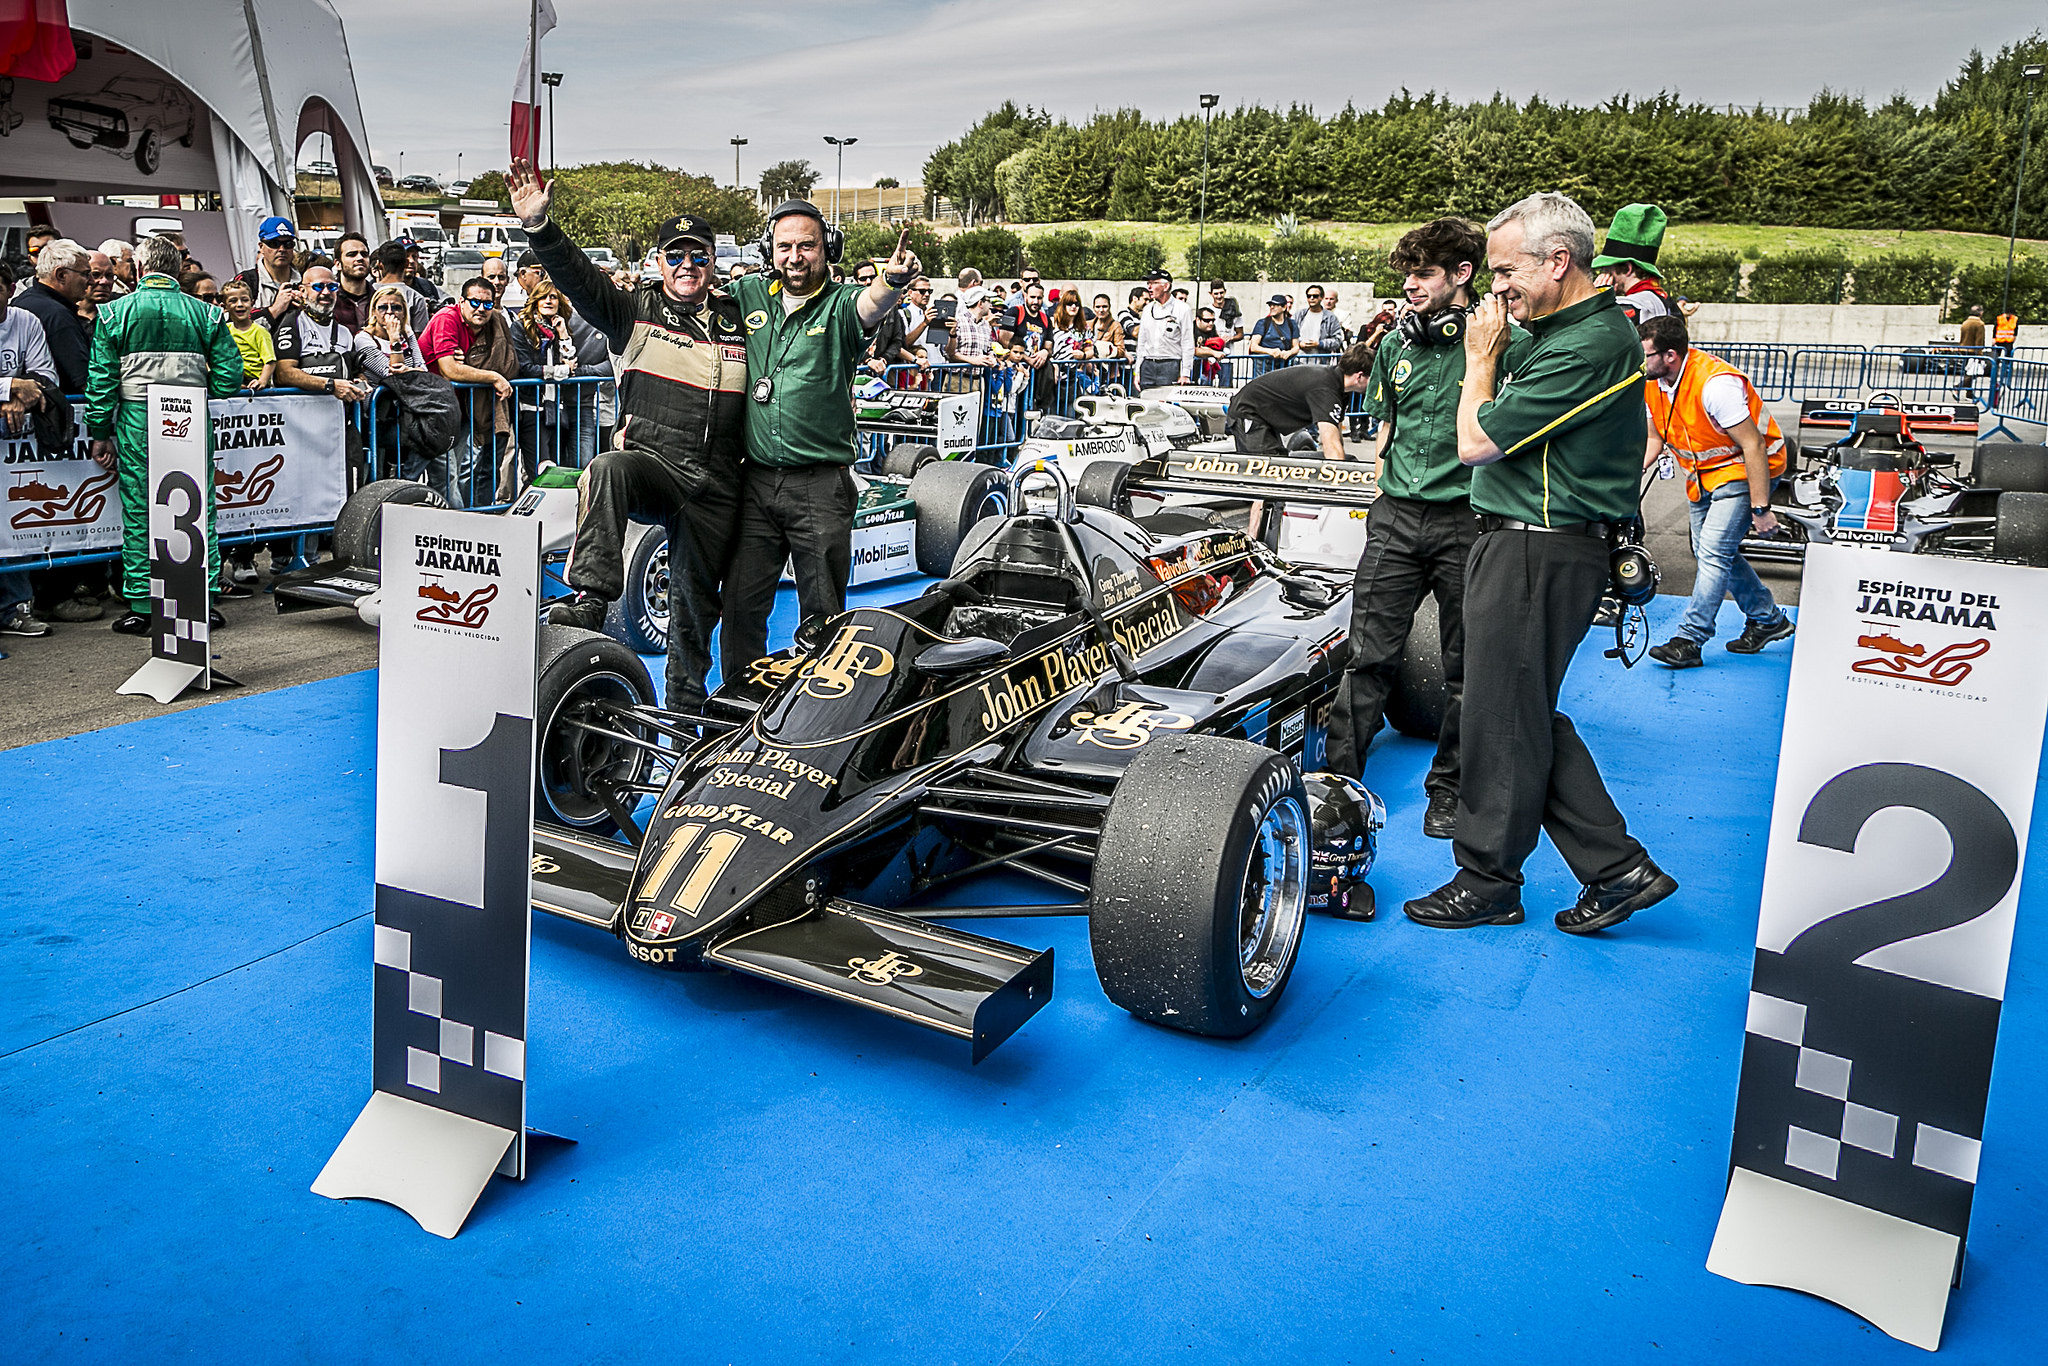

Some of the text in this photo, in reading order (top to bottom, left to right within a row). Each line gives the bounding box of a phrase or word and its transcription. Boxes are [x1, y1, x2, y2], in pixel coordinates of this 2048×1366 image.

[160, 403, 193, 414] JARAMA
[212, 413, 286, 430] PÍRITU DEL
[943, 435, 973, 449] saudia
[1075, 439, 1126, 457] AMBROSIO
[1184, 456, 1377, 486] John Player Spec
[76, 525, 122, 535] VELOCIDAD
[154, 470, 206, 568] 3
[864, 508, 905, 525] GOODYEAR
[414, 533, 502, 558] ESPÍRITU DEL
[1824, 529, 1908, 544] Valvoline
[414, 548, 502, 577] JARAMA
[853, 543, 887, 566] Mobil
[1857, 580, 2001, 609] ESPÍRITU DEL
[1855, 595, 1997, 631] JARAMA
[413, 623, 441, 633] FESTIVAL
[464, 632, 501, 642] VELOCIDAD
[978, 592, 1184, 732] John Player Special
[1846, 675, 1889, 688] FESTIVAL
[1929, 688, 1988, 703] VELOCIDAD
[755, 748, 838, 790] Player
[706, 767, 797, 801] Special
[438, 711, 534, 912] 1
[662, 803, 795, 846] GOODYEAR
[634, 822, 748, 919] 11
[1782, 762, 2019, 998] 2
